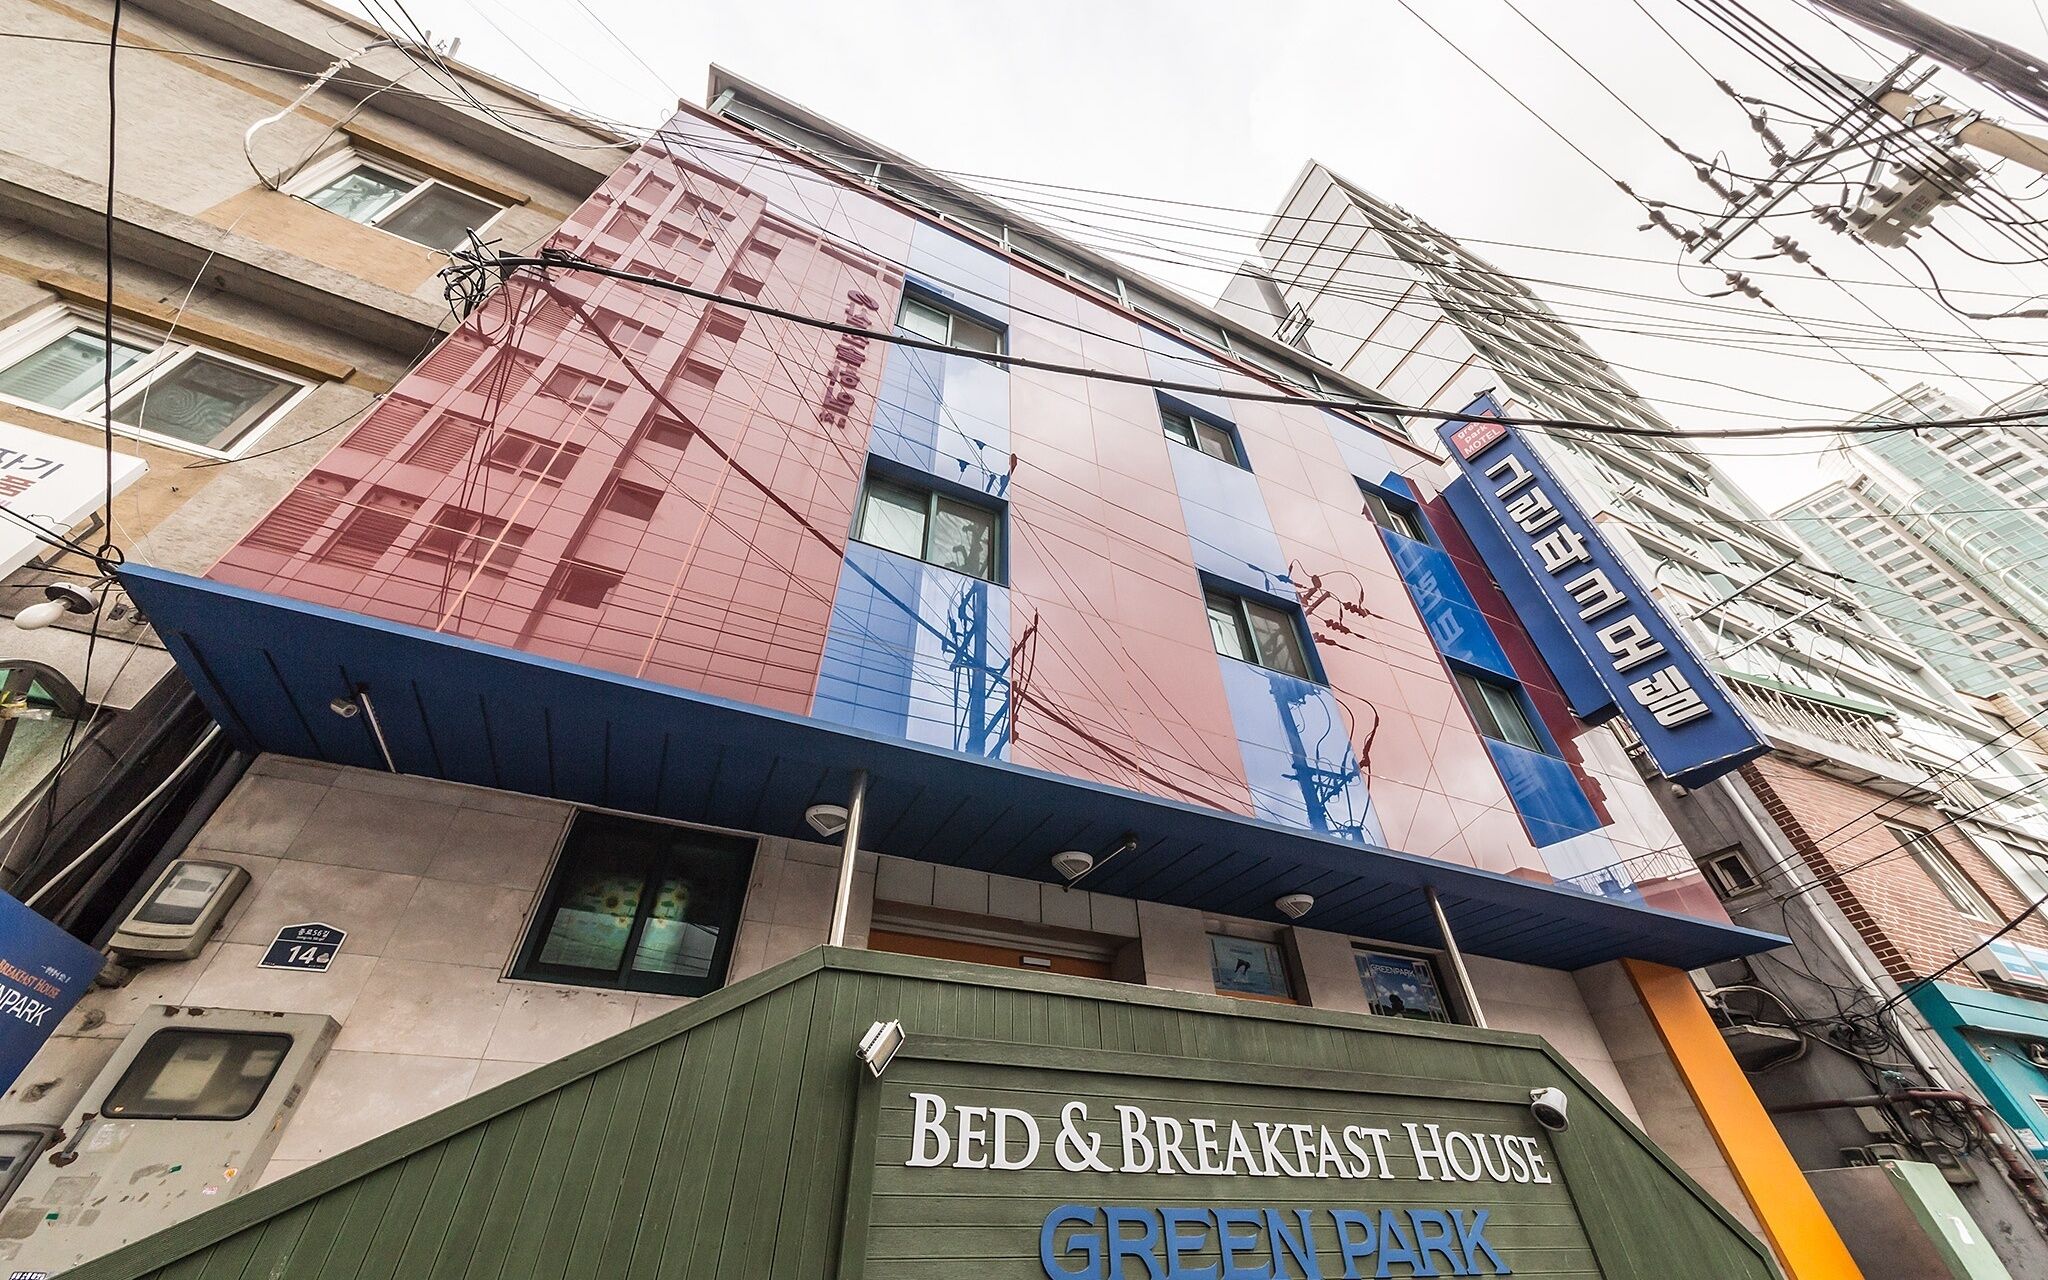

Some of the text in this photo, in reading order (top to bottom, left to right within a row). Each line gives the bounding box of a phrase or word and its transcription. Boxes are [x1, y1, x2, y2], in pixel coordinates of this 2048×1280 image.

[1464, 424, 1488, 443] park
[1464, 429, 1500, 455] MOTEL
[1484, 453, 1712, 729] 그린파크모텔
[287, 944, 319, 965] 14
[0, 959, 38, 988] BREAKFAST
[33, 978, 61, 999] HOUSE
[904, 1092, 1552, 1185] BED & BREAKFAST HOUSE
[1039, 1204, 1513, 1280] GREEN PARK
